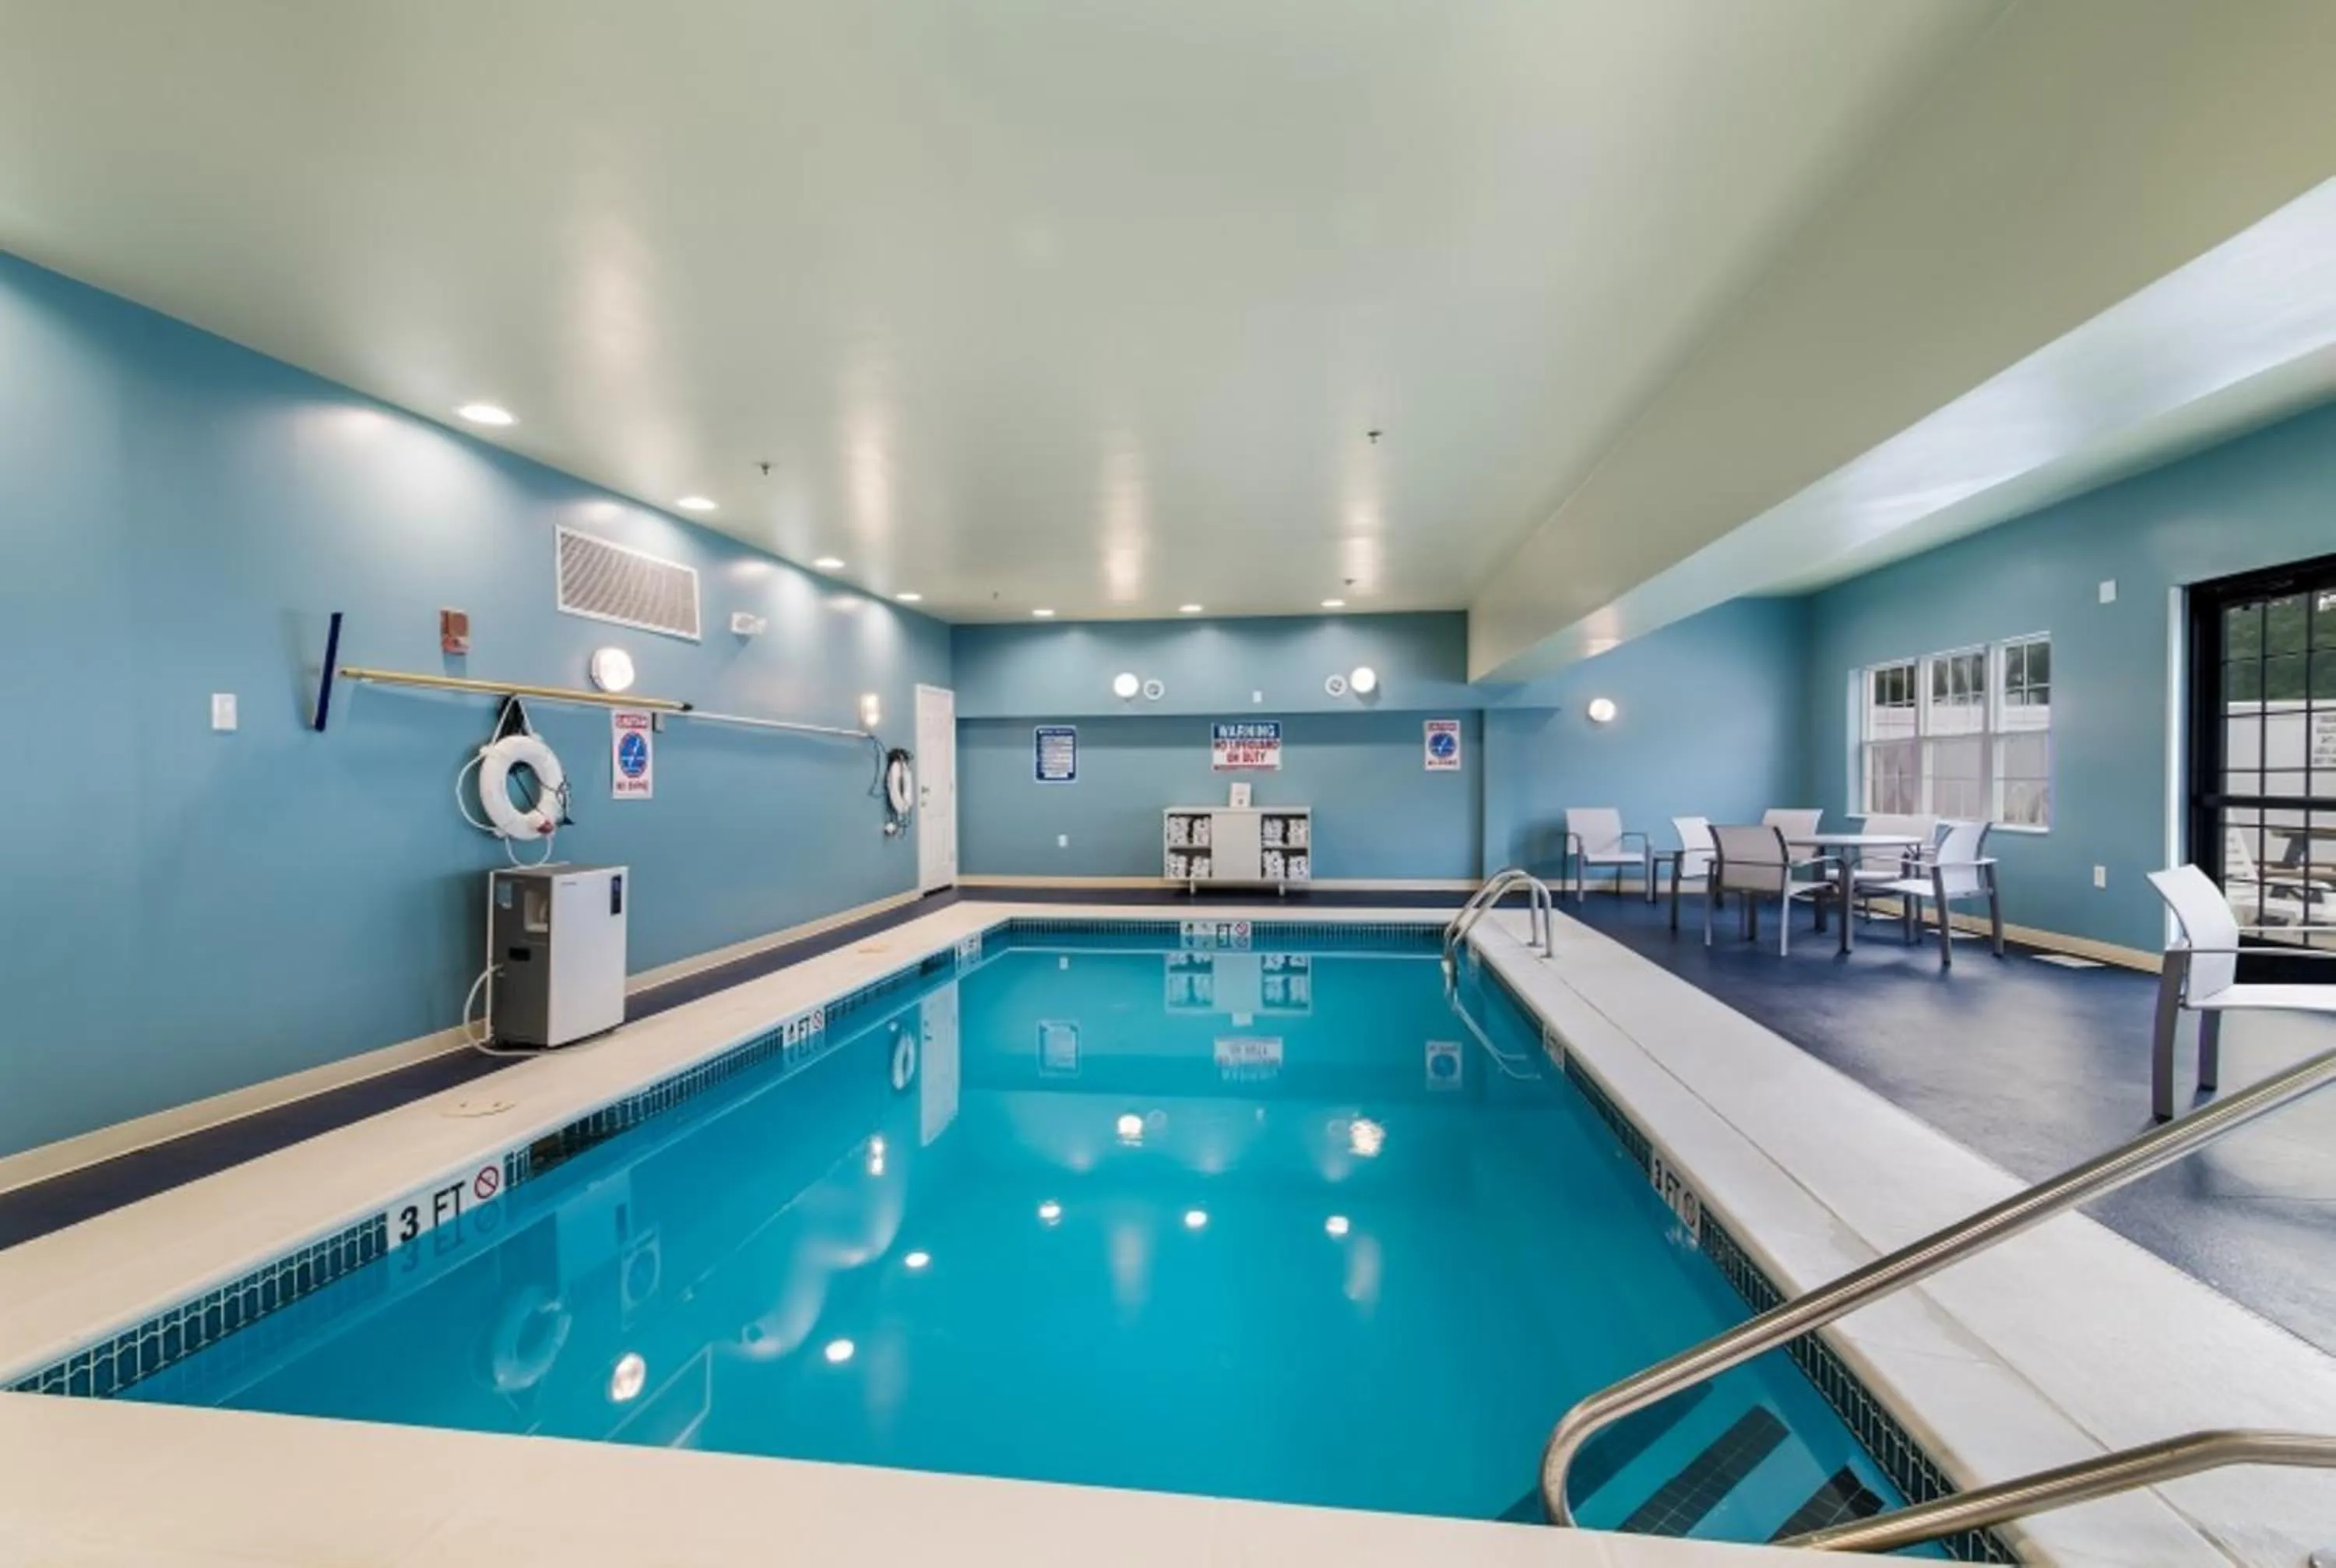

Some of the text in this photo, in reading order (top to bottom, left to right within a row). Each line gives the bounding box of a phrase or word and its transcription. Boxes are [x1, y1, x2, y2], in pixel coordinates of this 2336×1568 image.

[1219, 724, 1275, 738] WARNING
[399, 1180, 466, 1243] 3 FT
